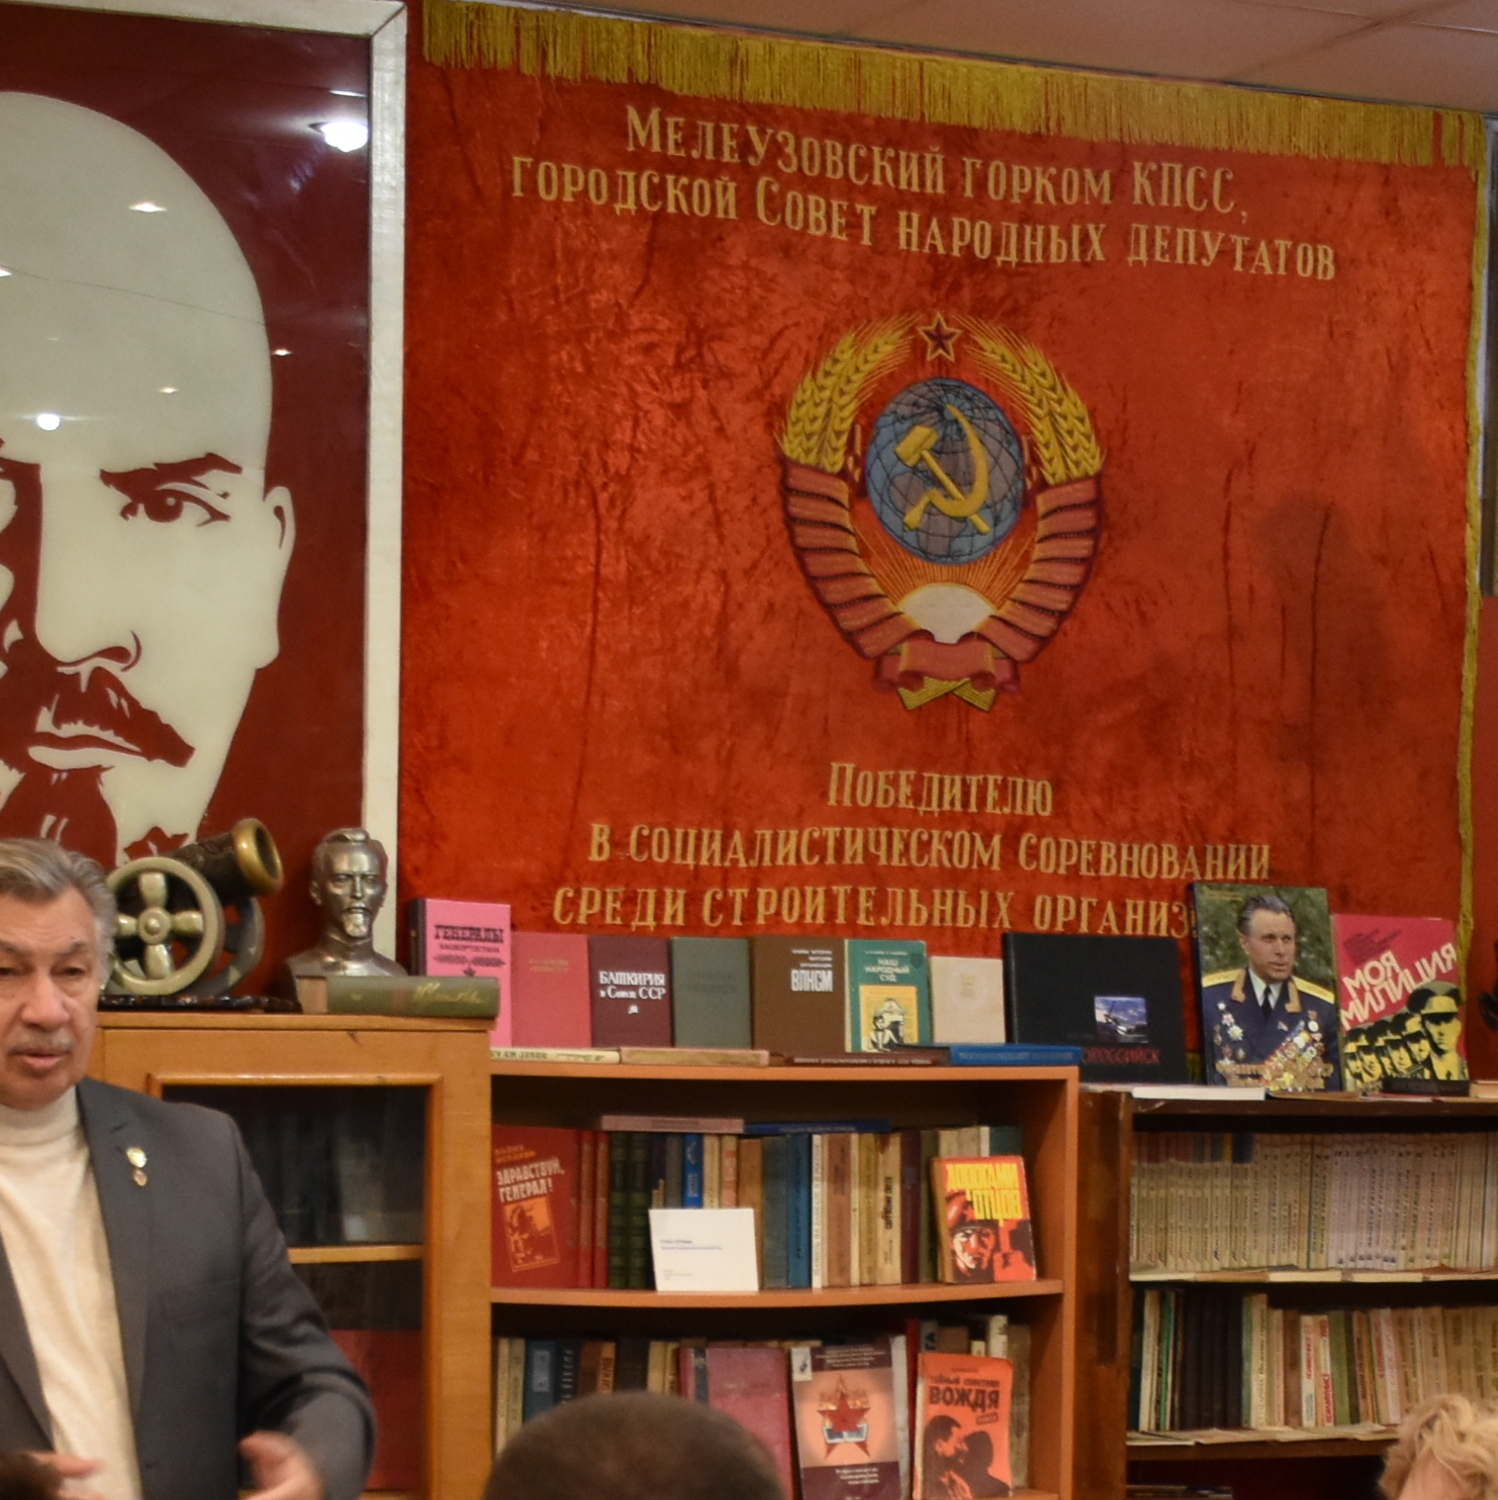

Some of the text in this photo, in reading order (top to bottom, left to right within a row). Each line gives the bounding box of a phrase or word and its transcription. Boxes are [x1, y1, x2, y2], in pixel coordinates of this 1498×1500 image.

[625, 104, 1248, 224] МЕЛЕУЗОВСКИЙ ГОРКОМ КПСС,
[511, 155, 1336, 281] ГОРОДСКОЙ СОВЕТ НАРОДНЫХ ДЕПУТАТОВ
[827, 761, 1054, 817] ПОБЕДИТЕЛЮ
[588, 822, 1271, 883] В СОЦИАЛИСТИЧЕСКОМ СОРЕВНОВАНИИ
[552, 885, 1193, 940] СРЕДИ СТРОИТЕЛЬНЫХ ОРГАНИЗ
[599, 970, 666, 986] БАШКИРИЯ
[638, 987, 667, 1000] ССР
[1339, 941, 1458, 1032] МИЛИЦИЯ
[1342, 950, 1400, 998] МОЯ
[498, 1174, 554, 1202] ГЕНЕРАЛ!
[929, 1384, 1000, 1413] ВОЖДЯ
